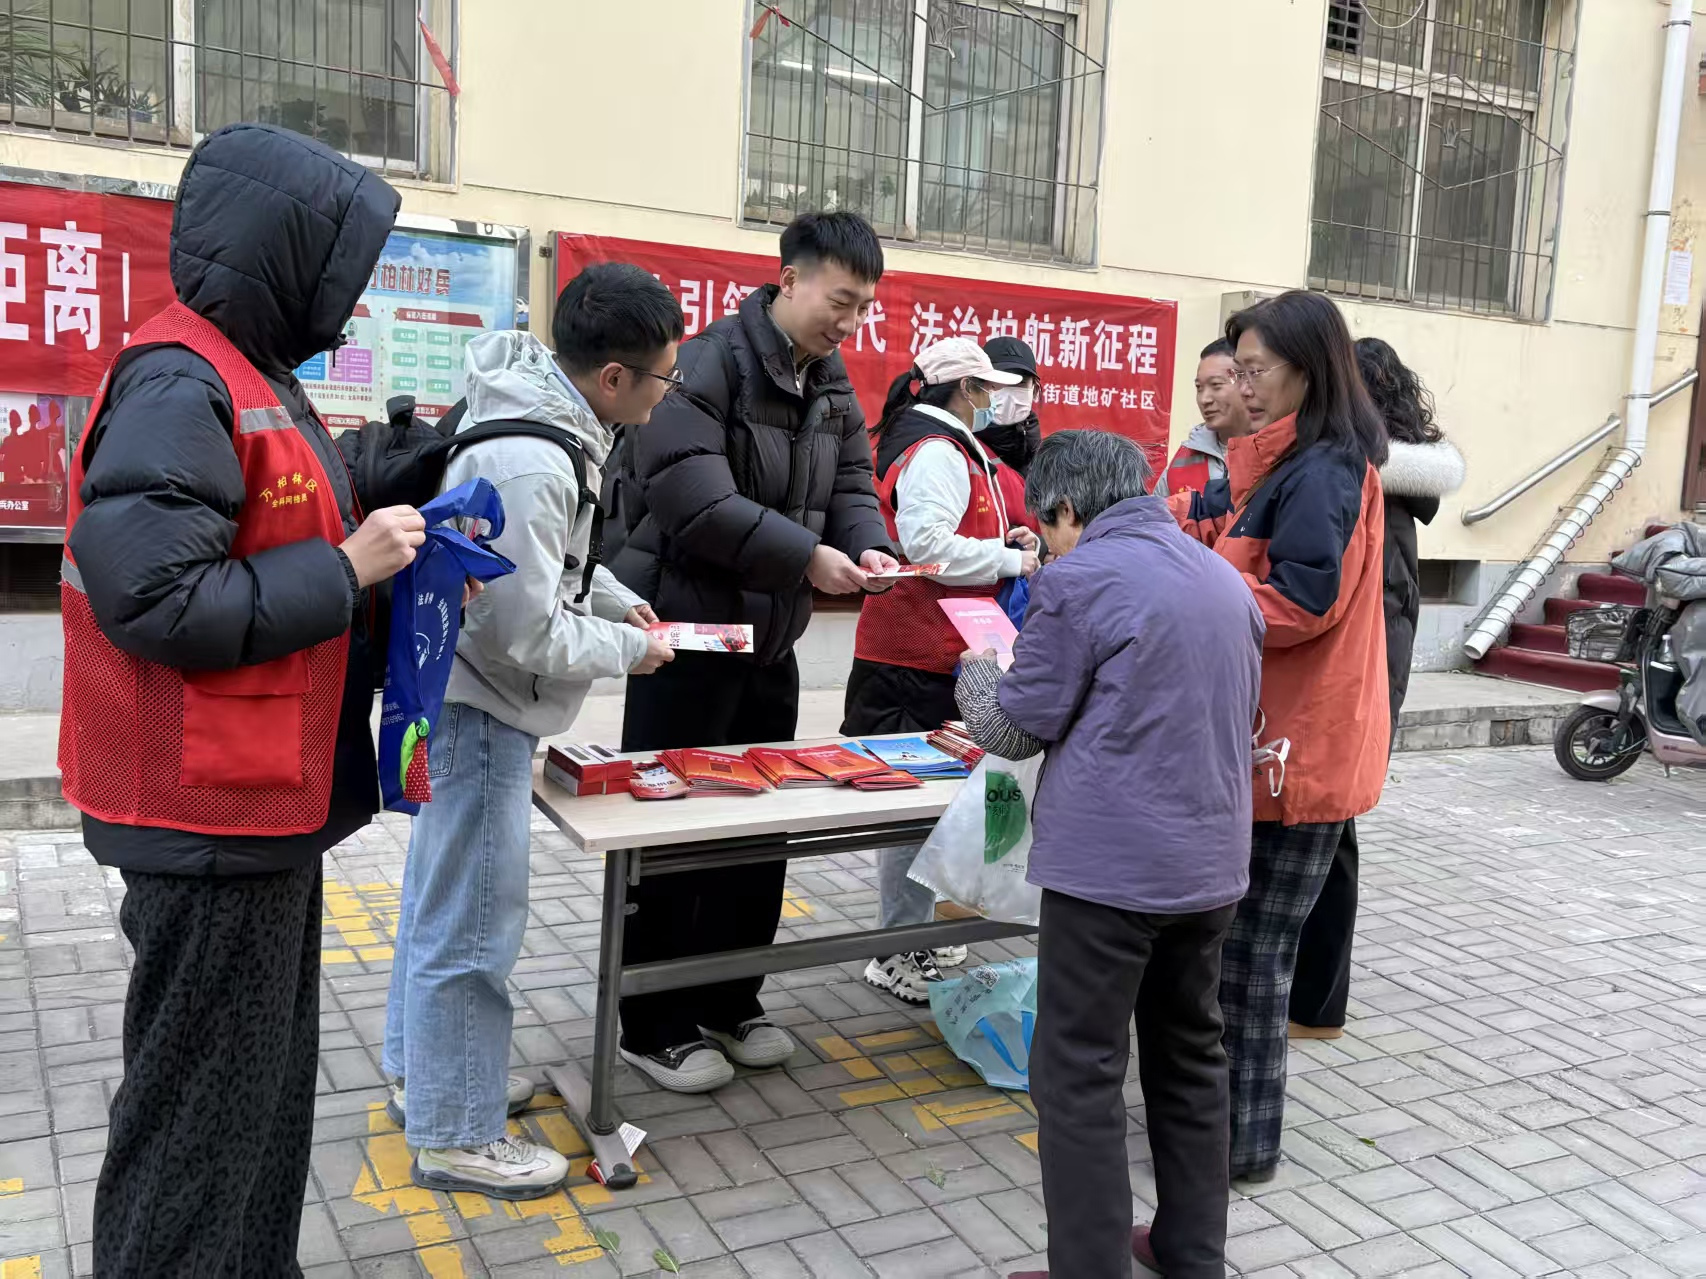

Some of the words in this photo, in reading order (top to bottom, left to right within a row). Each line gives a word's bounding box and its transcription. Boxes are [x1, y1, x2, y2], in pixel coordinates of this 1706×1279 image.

[910, 301, 1158, 375] 法治护航新征程
[1034, 383, 1156, 411] 街道地矿社区
[259, 471, 318, 503] 万柏林区
